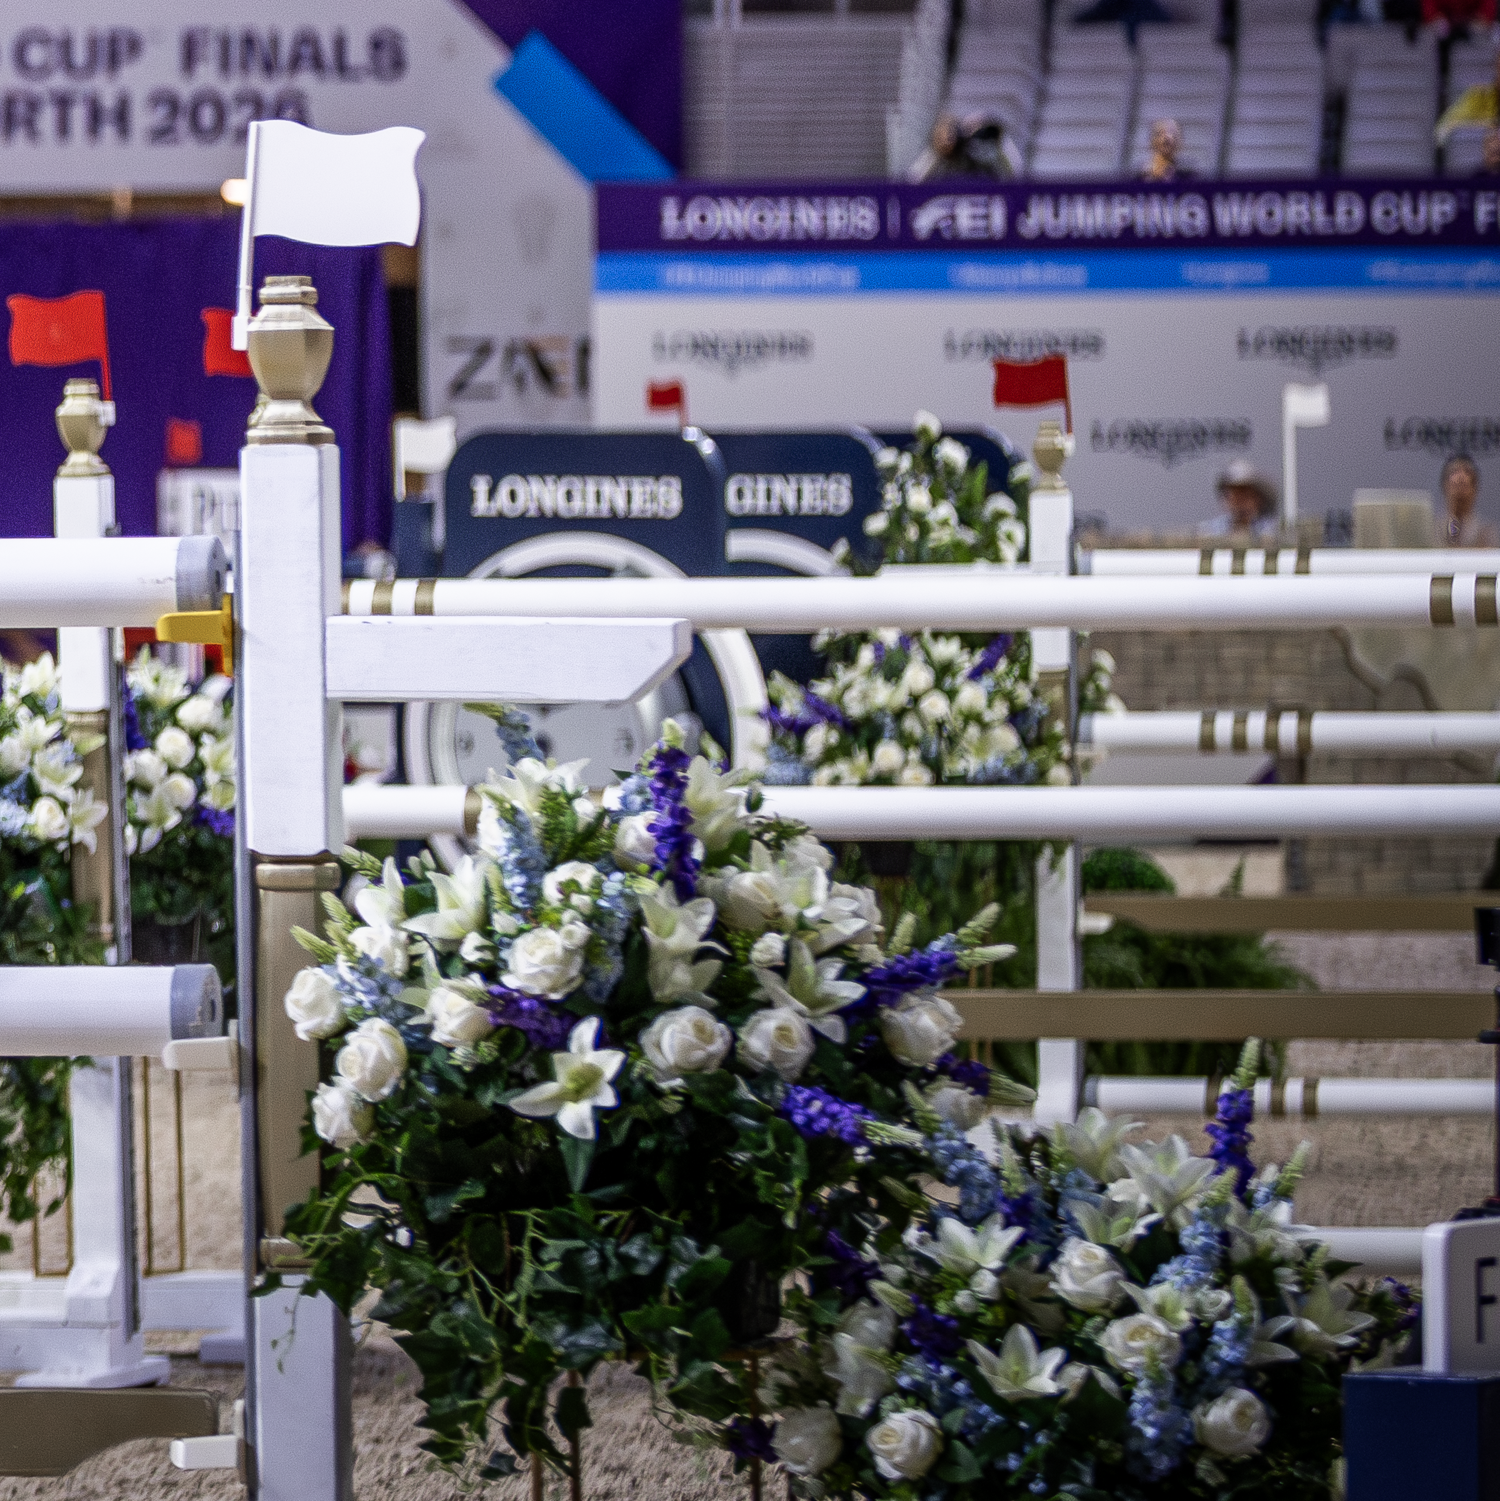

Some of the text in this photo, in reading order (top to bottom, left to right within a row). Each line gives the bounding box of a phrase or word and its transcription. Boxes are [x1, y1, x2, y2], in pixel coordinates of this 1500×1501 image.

[11, 24, 145, 83] CUP
[178, 24, 409, 84] FINALS
[659, 195, 881, 241] LONGINES
[1016, 192, 1210, 239] JUMPING
[1212, 190, 1367, 237] WORLD
[1370, 189, 1459, 236] CUP
[470, 474, 683, 519] LONGINES
